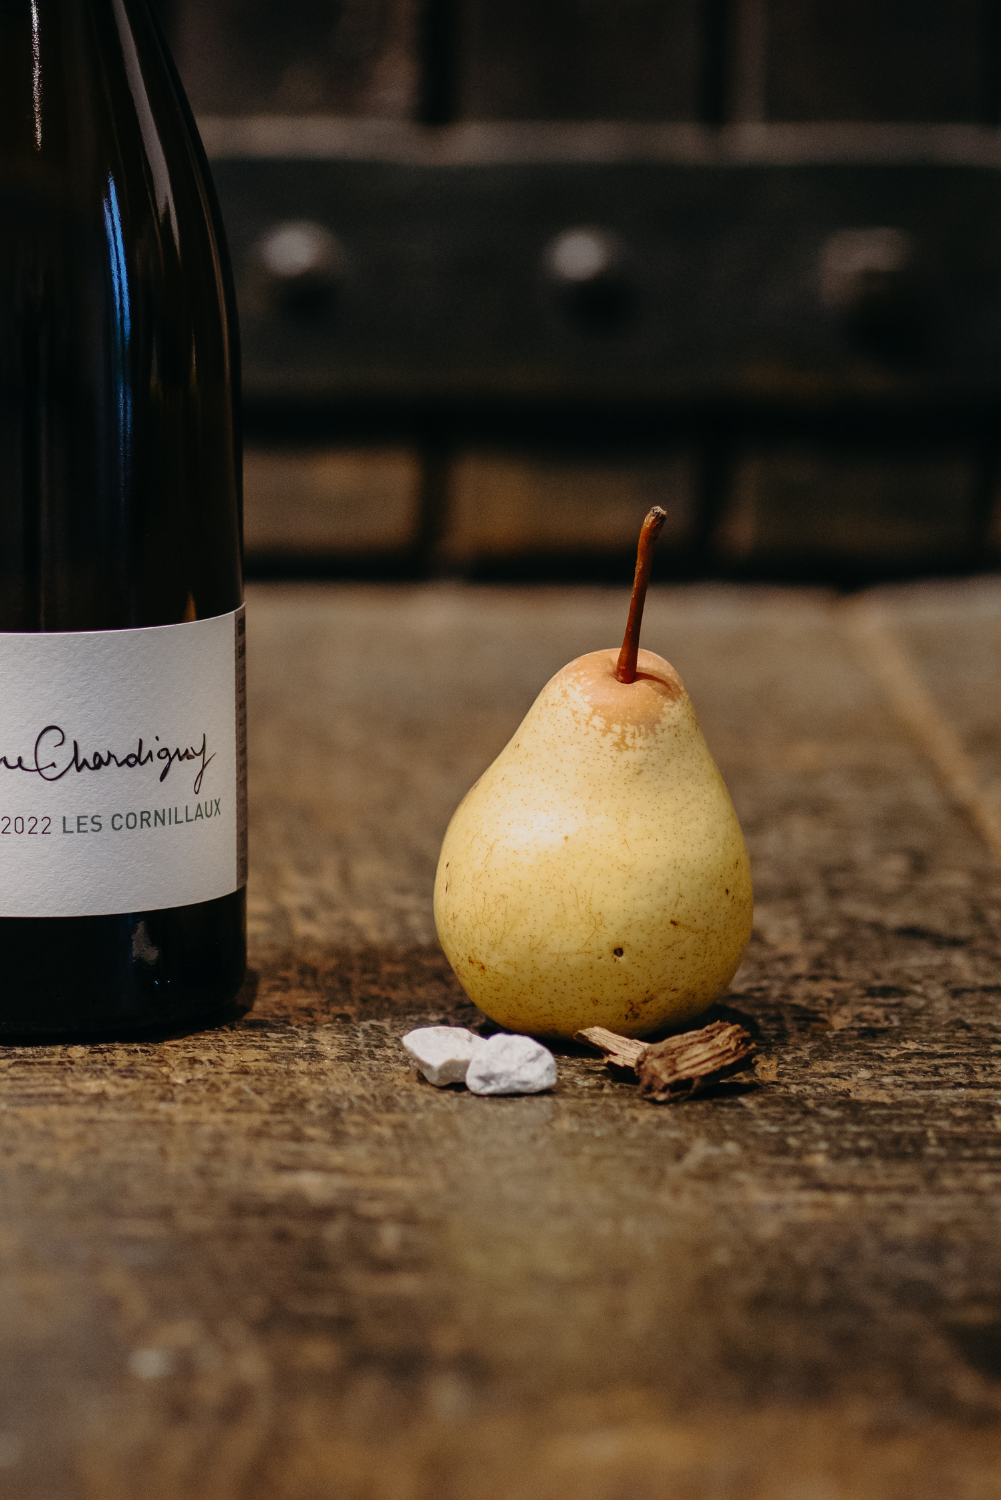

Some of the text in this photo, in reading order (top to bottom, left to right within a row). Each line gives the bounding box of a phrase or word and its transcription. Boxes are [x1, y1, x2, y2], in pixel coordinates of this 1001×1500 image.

[34, 724, 217, 795] Chardigny
[0, 816, 52, 835] 2022
[62, 814, 103, 834] LES
[110, 797, 222, 832] CORNILLAUX
